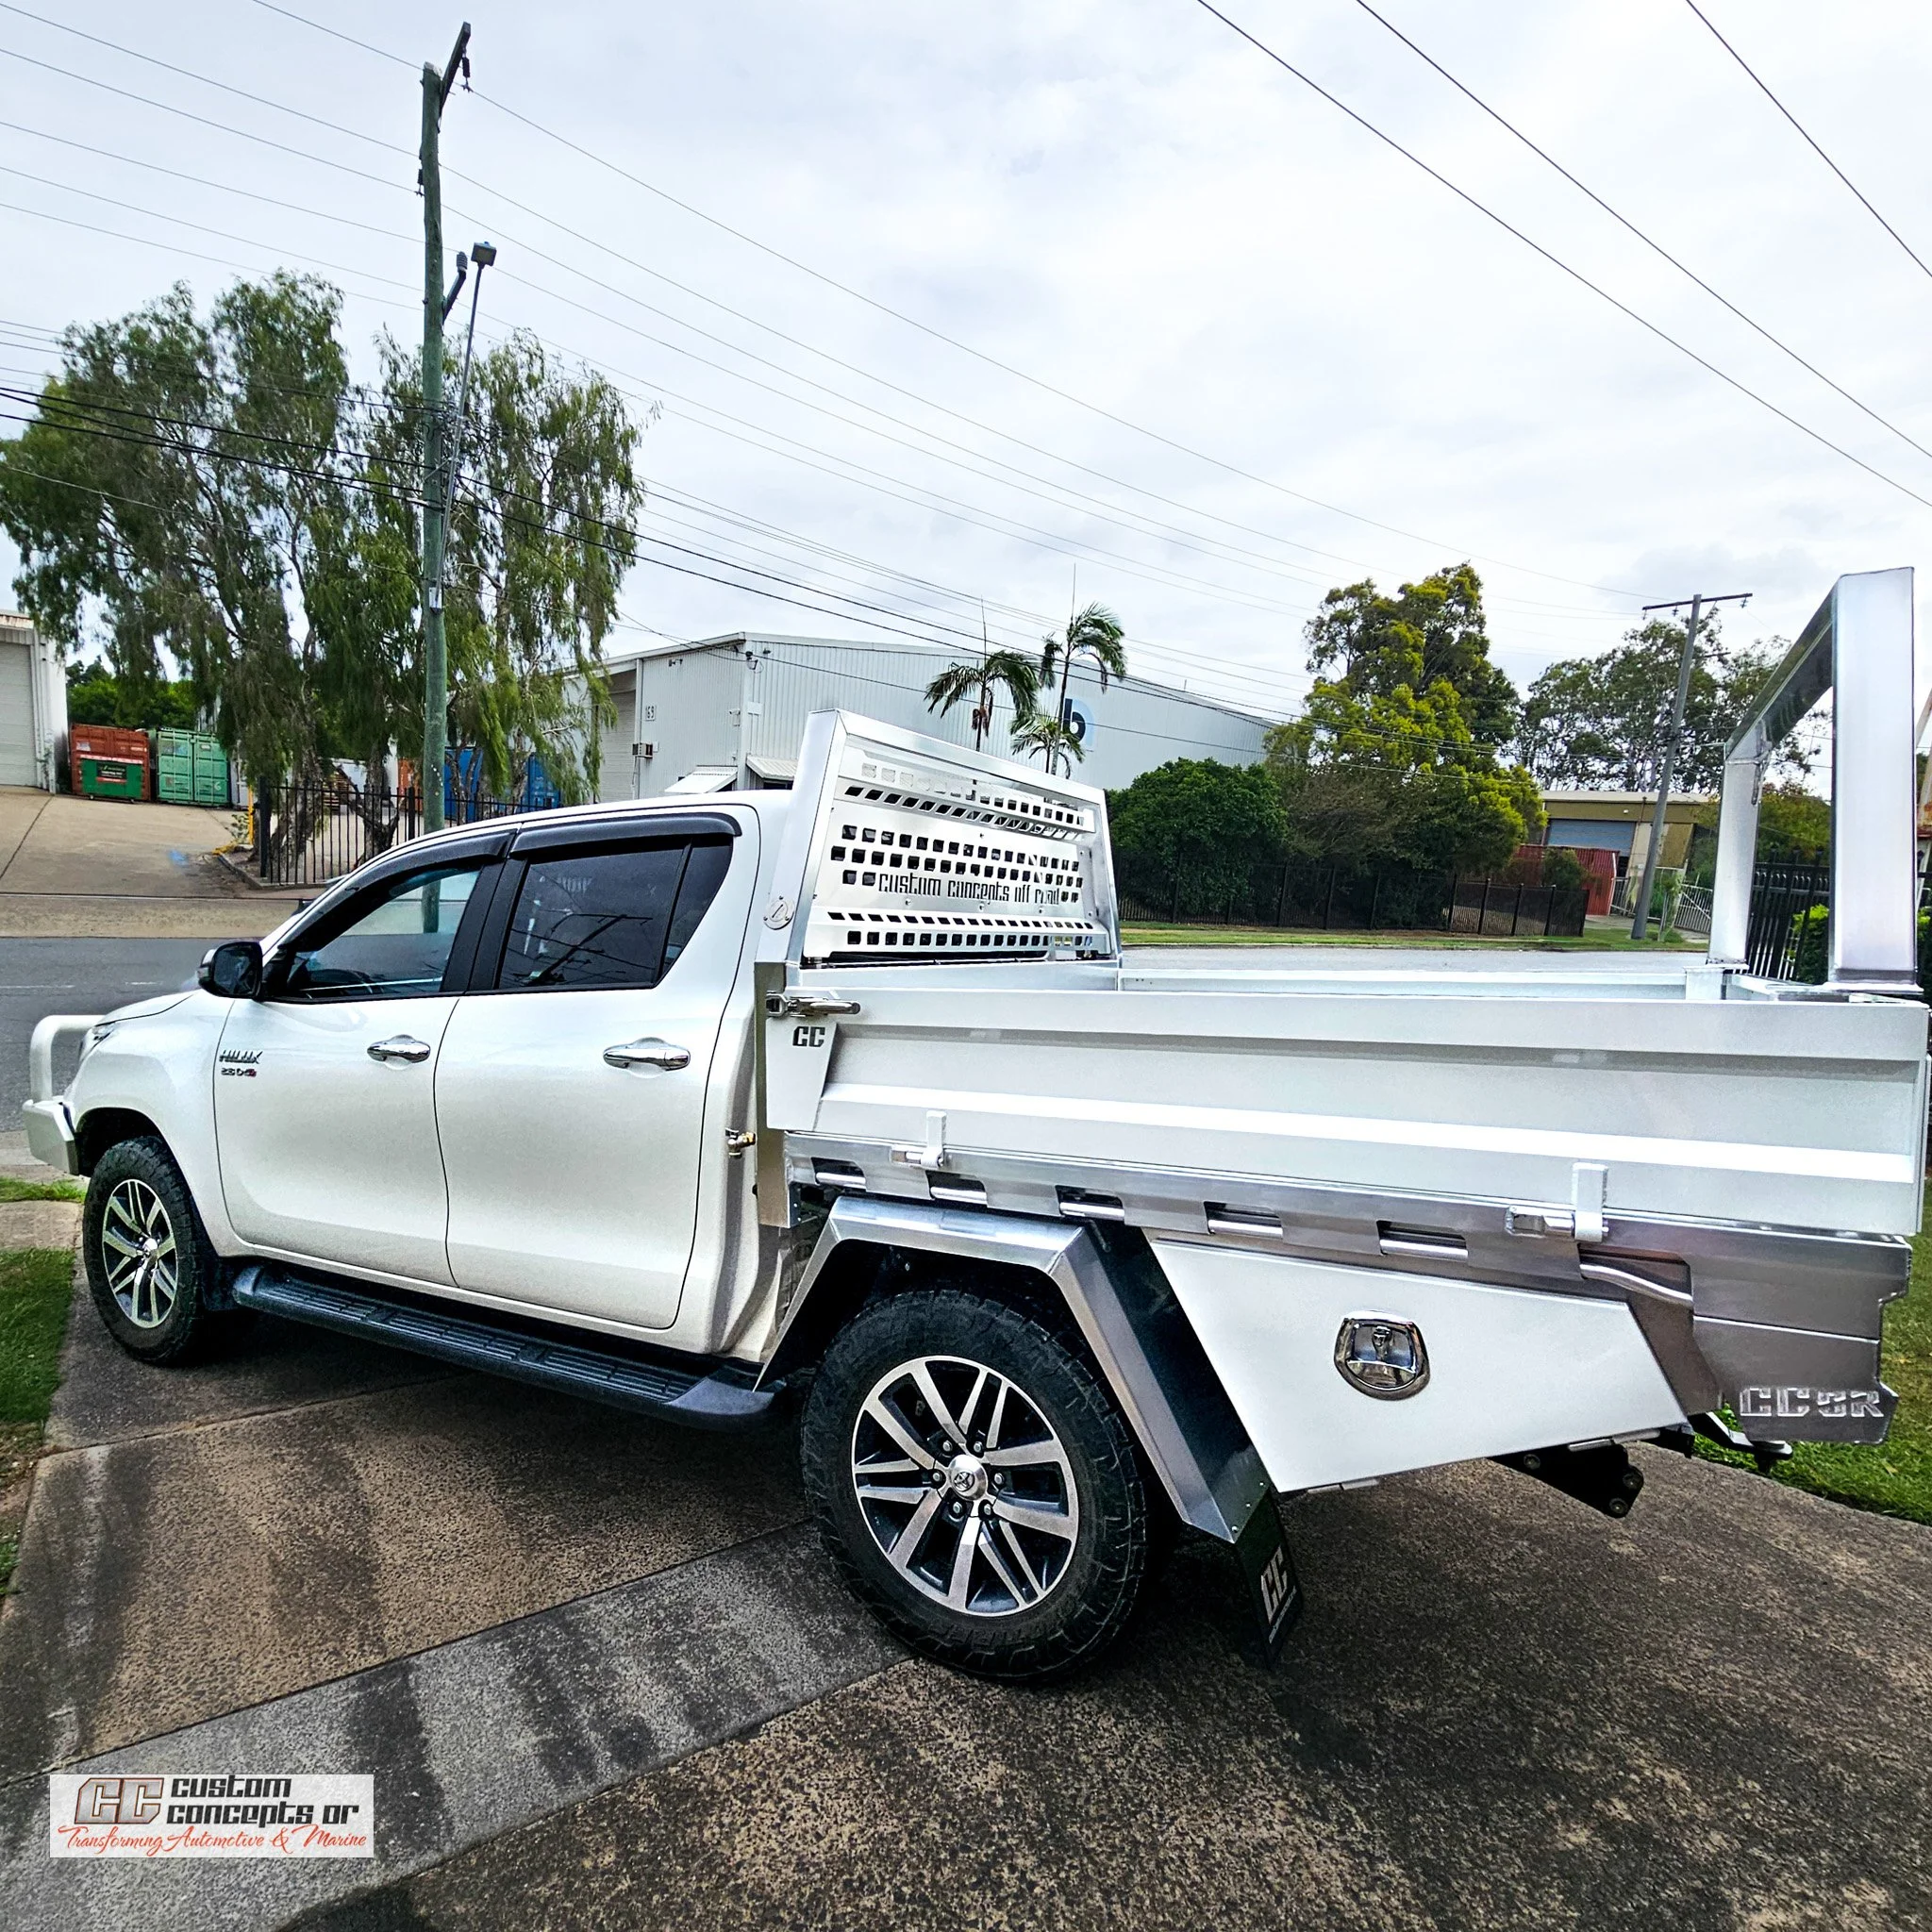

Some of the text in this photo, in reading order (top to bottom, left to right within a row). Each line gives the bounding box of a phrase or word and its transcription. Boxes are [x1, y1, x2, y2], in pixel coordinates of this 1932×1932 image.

[878, 872, 941, 896] custom
[947, 879, 1009, 903] concepts
[792, 1025, 825, 1047] CC
[1261, 1546, 1287, 1624] CC
